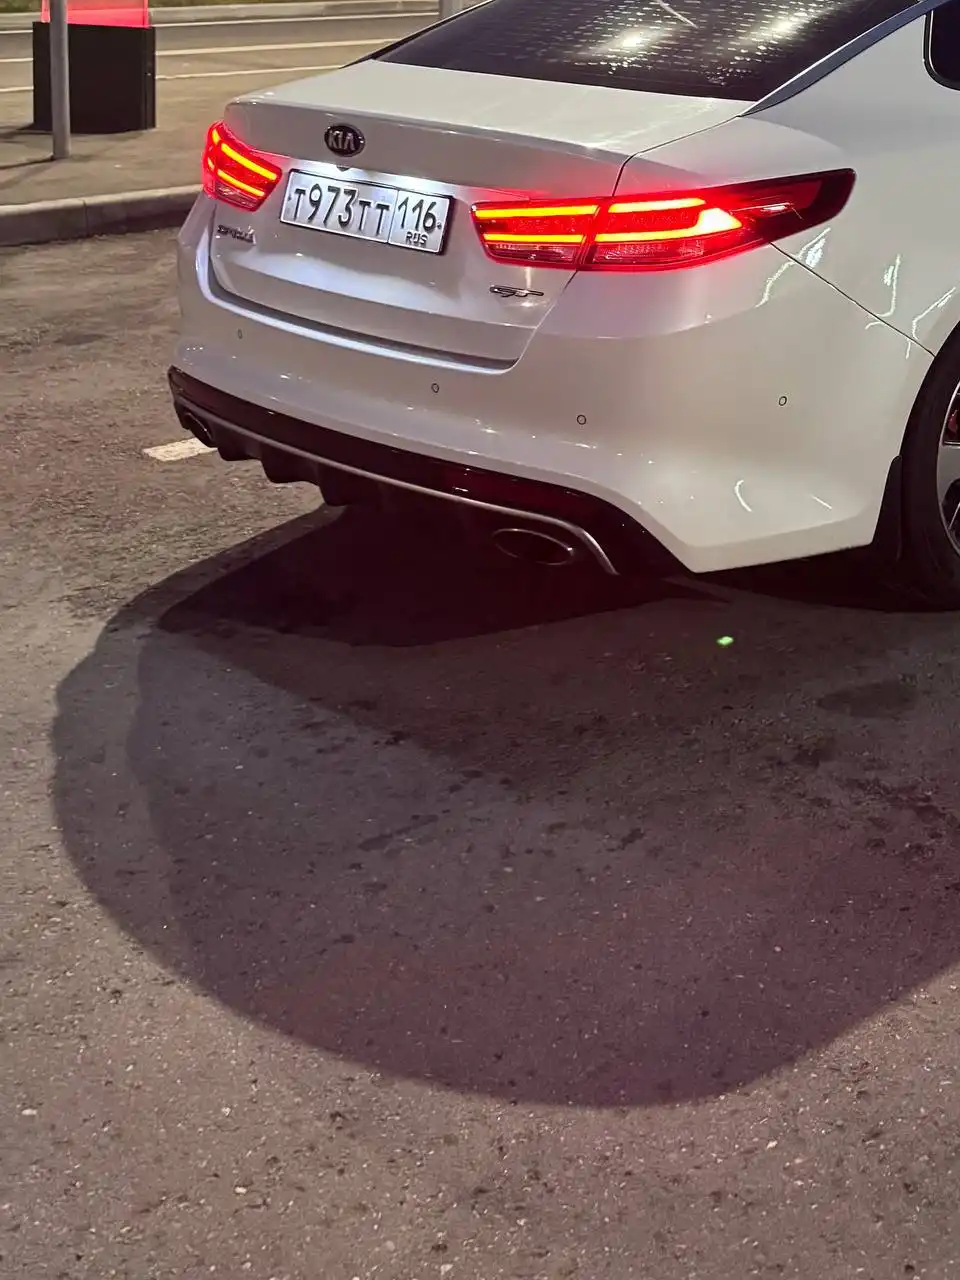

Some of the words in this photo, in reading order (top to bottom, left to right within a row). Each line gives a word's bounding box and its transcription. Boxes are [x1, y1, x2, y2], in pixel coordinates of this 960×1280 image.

[327, 129, 357, 151] KIA
[398, 196, 437, 232] 116
[405, 230, 428, 247] RUS
